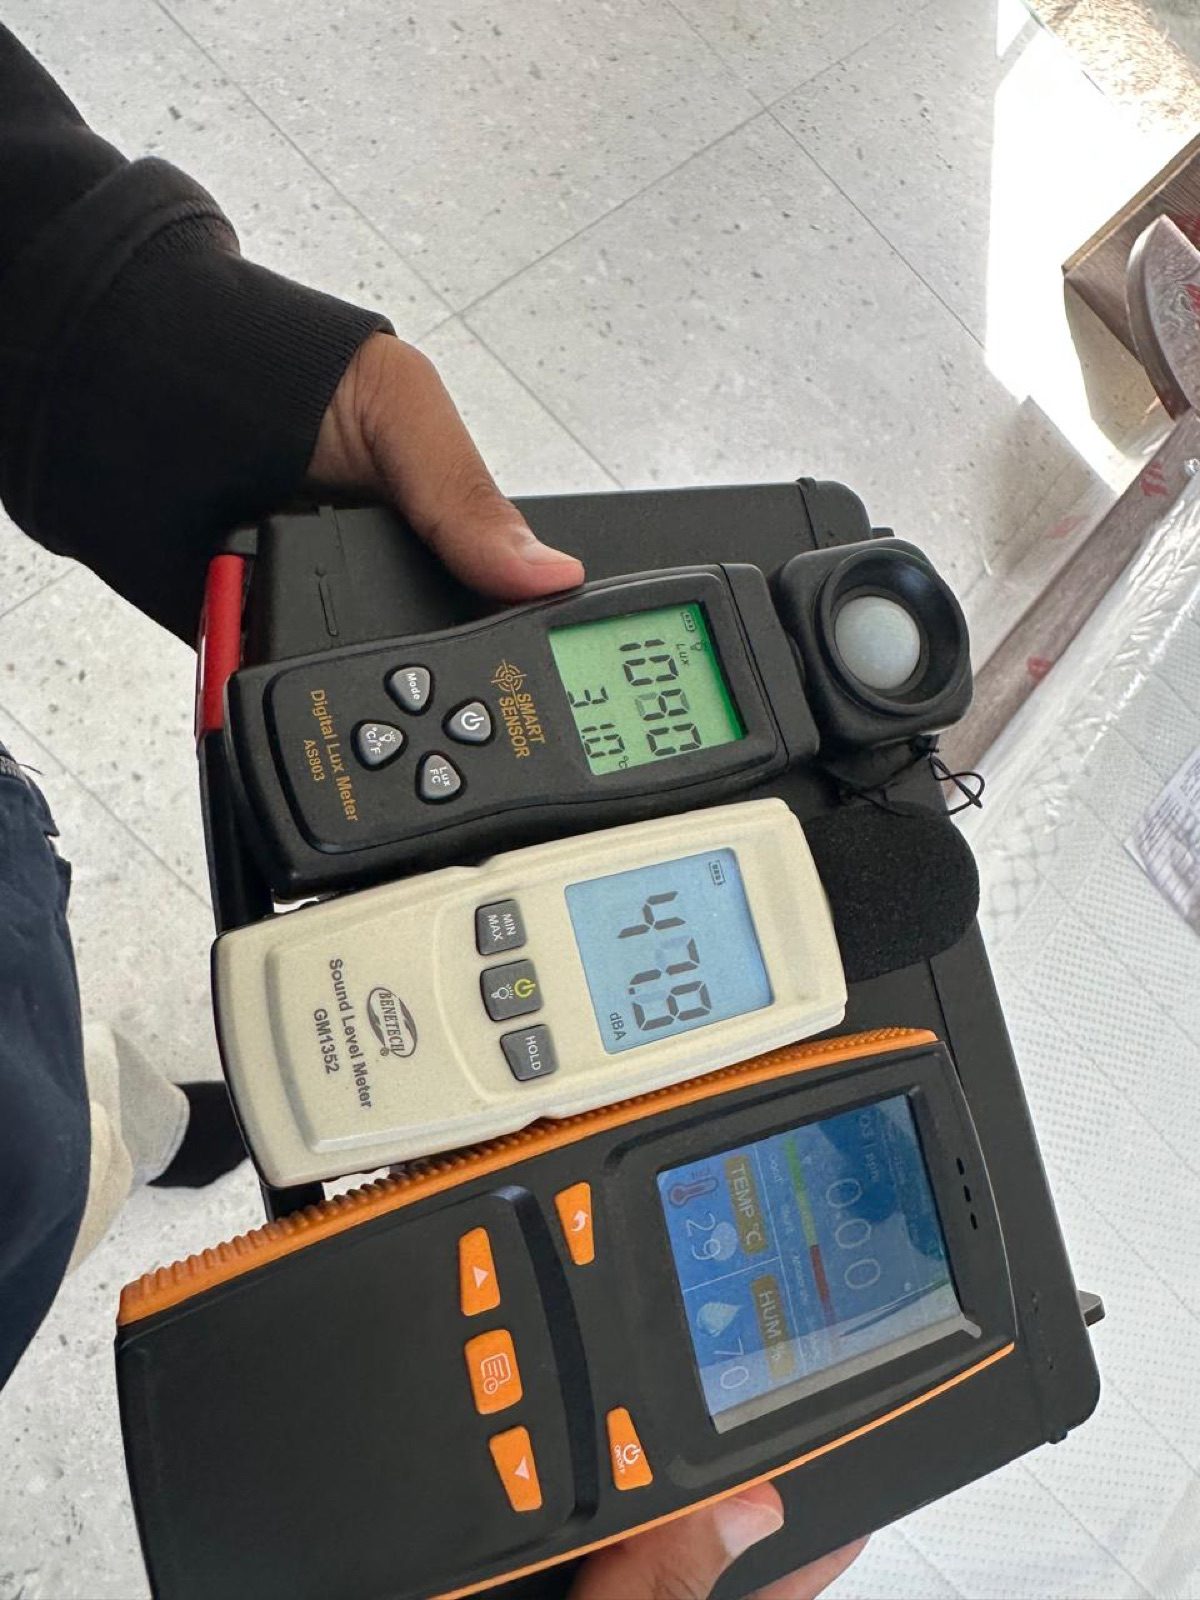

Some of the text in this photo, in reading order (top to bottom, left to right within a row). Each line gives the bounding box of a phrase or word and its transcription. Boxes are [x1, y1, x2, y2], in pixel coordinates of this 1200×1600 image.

[675, 643, 690, 666] Lux
[406, 672, 422, 701] Mode
[500, 697, 530, 760] SENSOR
[517, 693, 545, 744] SMART
[303, 739, 325, 781] AS803
[310, 689, 359, 822] Digital Lux Meter
[430, 769, 441, 784] FC
[438, 766, 451, 787] Lux
[488, 914, 504, 941] MAX
[503, 913, 517, 936] MIN
[617, 890, 712, 1031] 47.9
[313, 1008, 340, 1075] GM1352
[329, 958, 372, 1109] Sound Level Meter
[609, 1011, 627, 1041] dBA
[525, 1035, 541, 1071] HOLD
[730, 1163, 755, 1219] TEMP
[685, 1211, 721, 1260] 29
[825, 1178, 881, 1289] 0.00
[758, 1290, 781, 1340] HUM
[714, 1336, 749, 1390] 70
